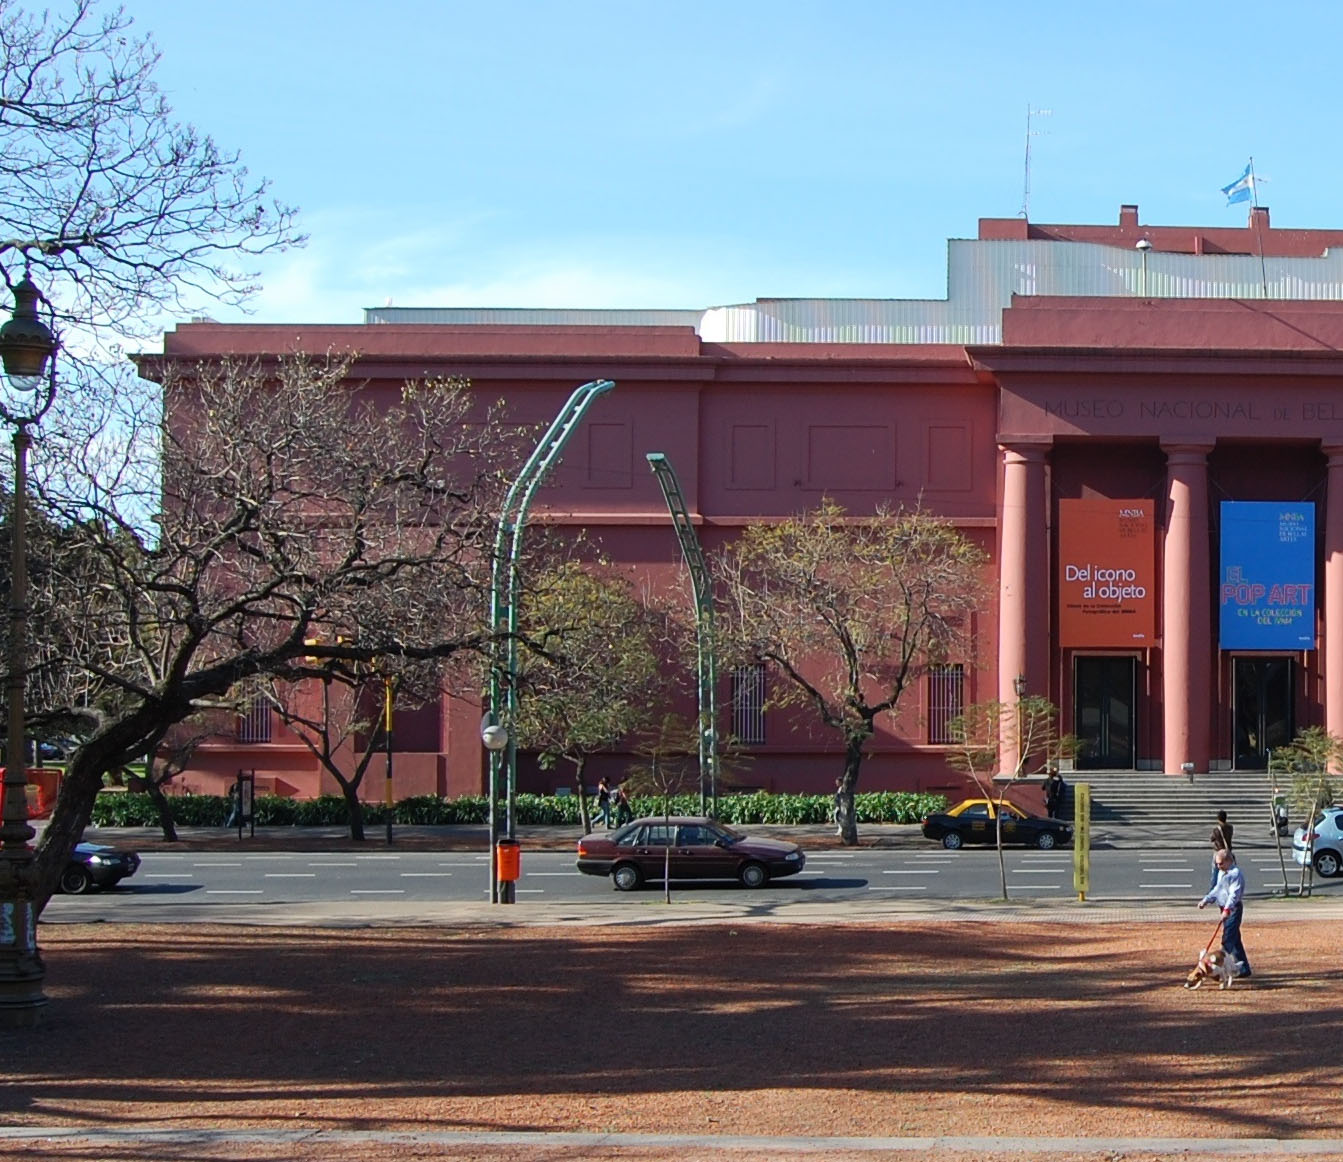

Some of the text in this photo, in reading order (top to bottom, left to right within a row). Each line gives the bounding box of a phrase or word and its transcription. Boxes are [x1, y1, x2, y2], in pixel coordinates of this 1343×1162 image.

[1044, 400, 1124, 418] MUSEO
[1141, 400, 1260, 420] NACIONAL
[1065, 564, 1135, 581] Del icono
[1083, 582, 1146, 602] al objeto
[1221, 583, 1312, 605] POP ART
[1237, 607, 1248, 617] EN
[1251, 607, 1260, 617] LA
[1257, 615, 1272, 625] DEL
